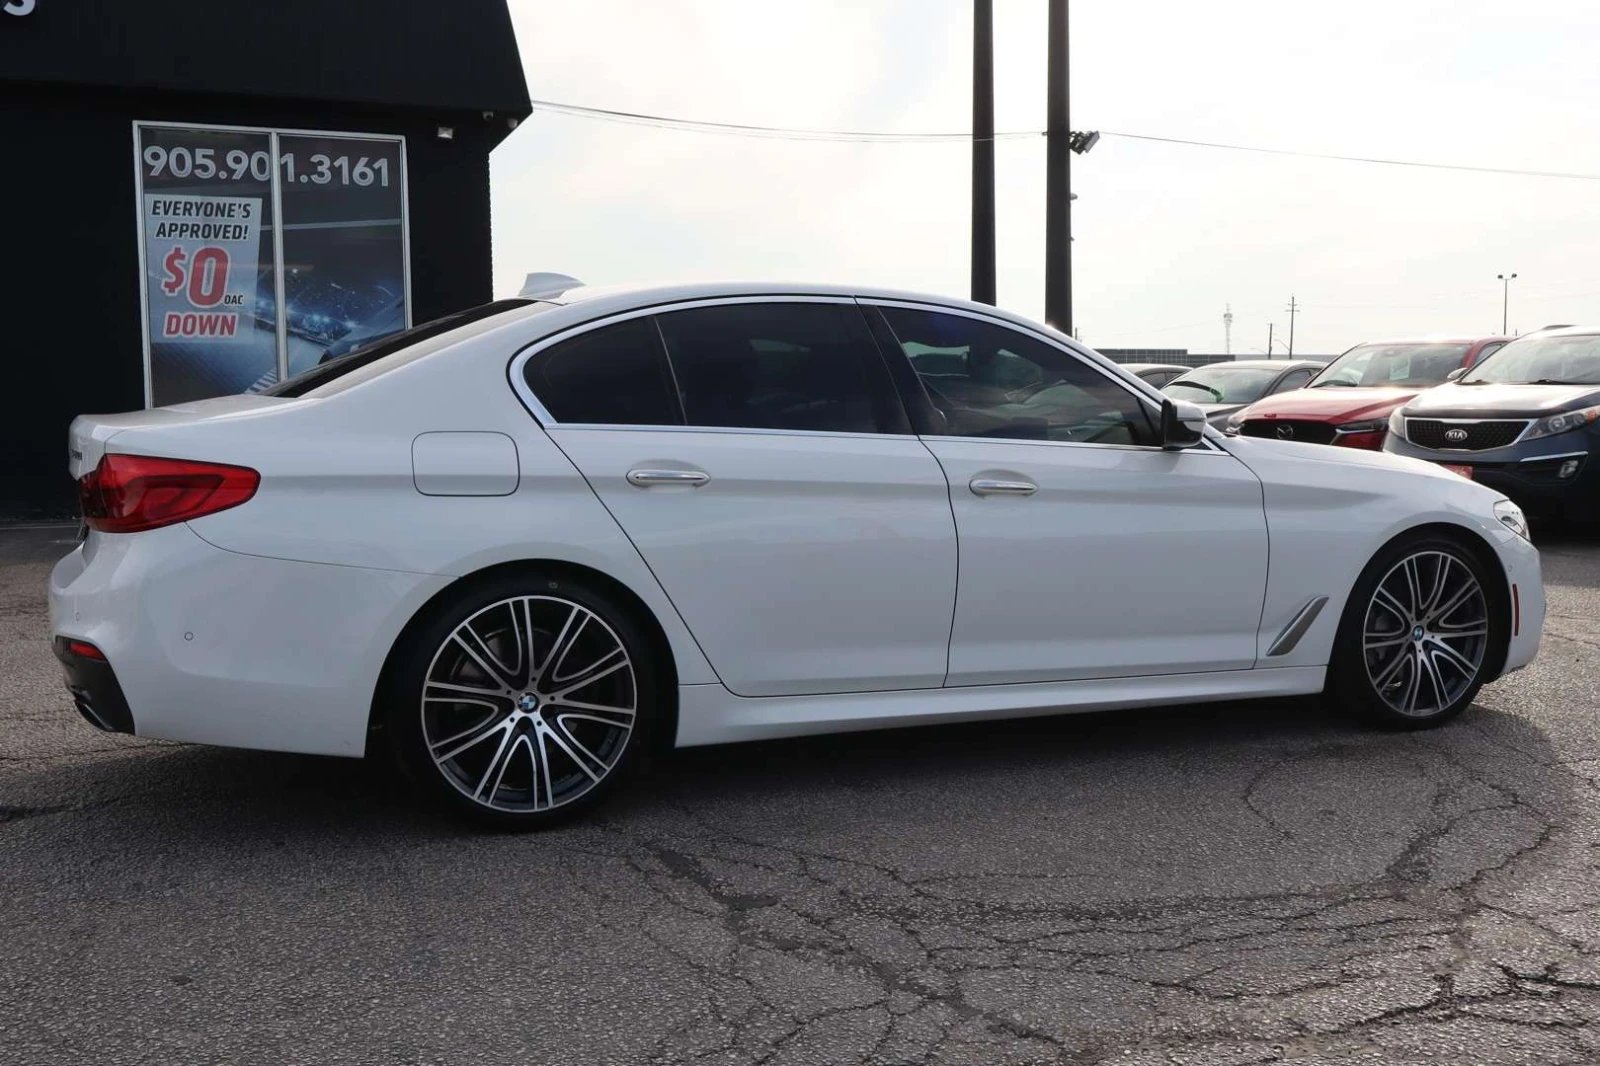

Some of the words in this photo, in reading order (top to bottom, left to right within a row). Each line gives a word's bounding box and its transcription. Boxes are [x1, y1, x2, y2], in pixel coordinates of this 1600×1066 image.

[143, 145, 389, 187] 905.901.3161
[151, 200, 251, 219] EVERYONE'S
[155, 222, 249, 240] APPROVED!
[163, 246, 230, 306] $0
[224, 294, 244, 306] OAC
[165, 313, 237, 336] DOWN
[1448, 430, 1464, 440] KIA
